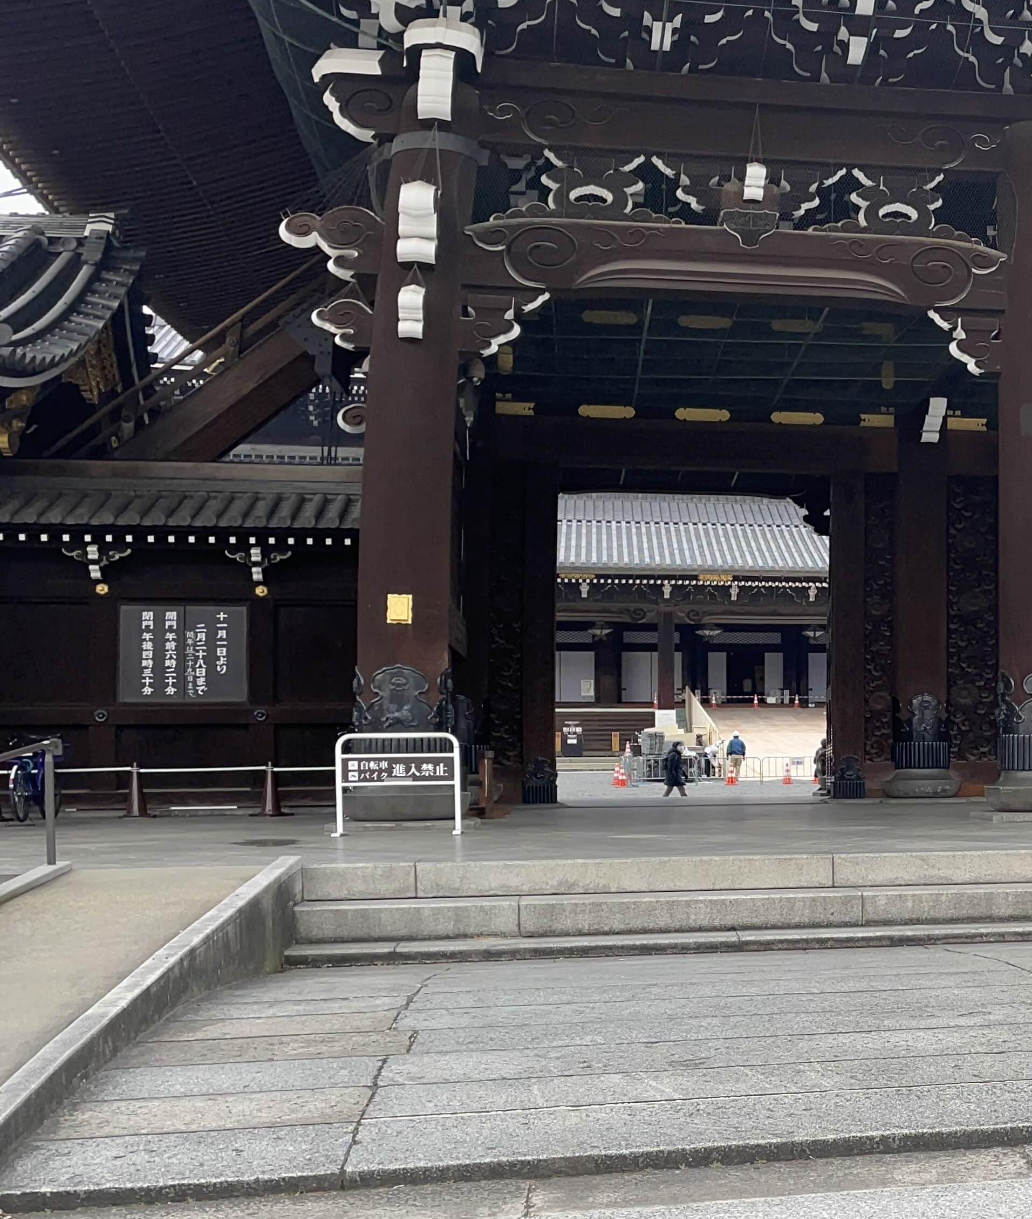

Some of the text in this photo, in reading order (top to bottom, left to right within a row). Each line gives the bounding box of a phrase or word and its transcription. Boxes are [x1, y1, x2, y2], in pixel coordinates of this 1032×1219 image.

[141, 611, 154, 695] 閉門 午後四時三十分
[164, 611, 177, 695] 開門 午前六時二十分
[195, 623, 207, 695] 二月二十八日まで
[216, 611, 228, 675] 十一月一日より
[360, 760, 389, 770] 自転車
[360, 771, 388, 781] バイク
[391, 762, 449, 777] 進入禁止
